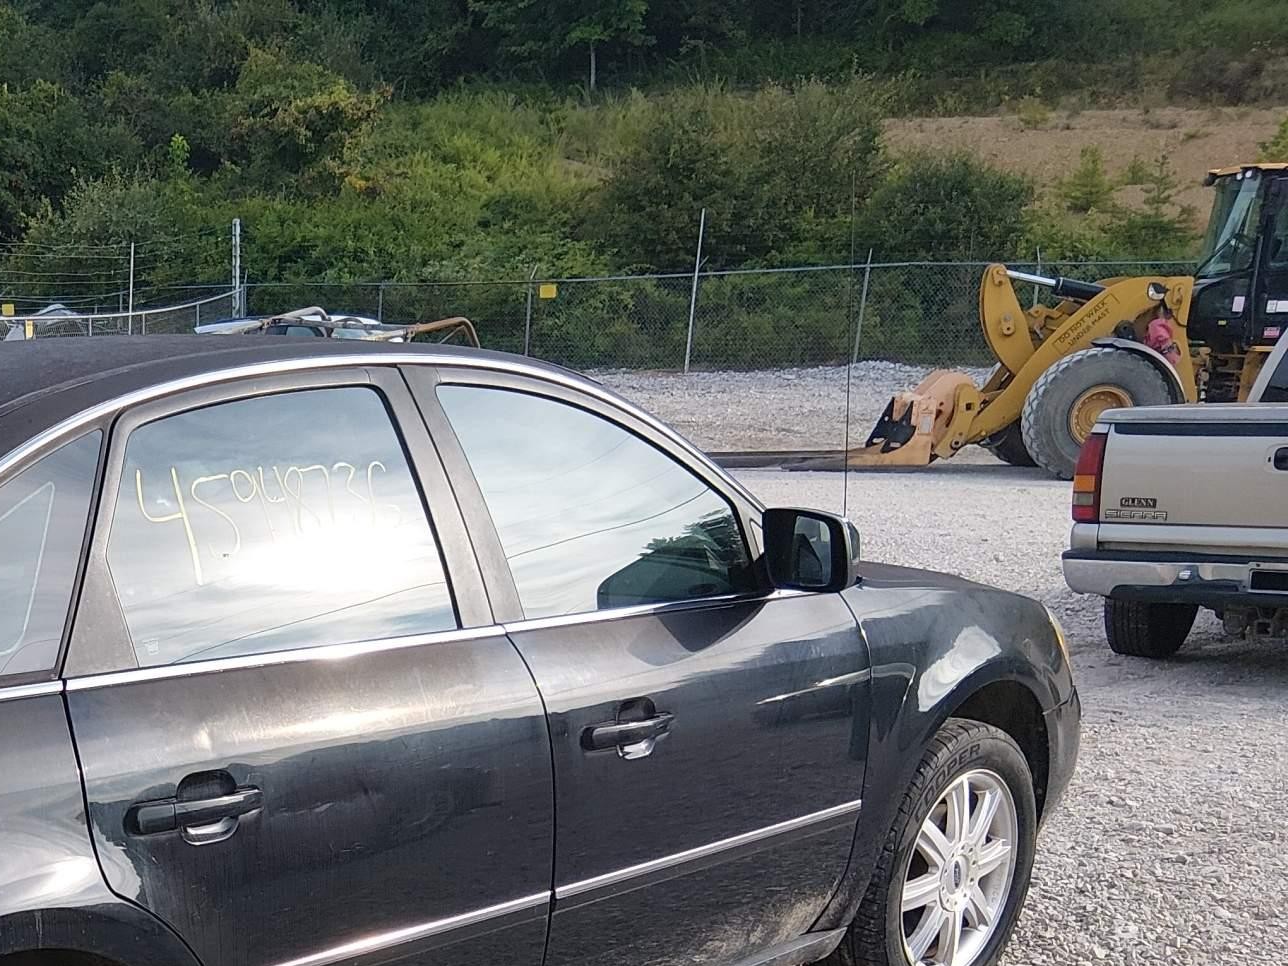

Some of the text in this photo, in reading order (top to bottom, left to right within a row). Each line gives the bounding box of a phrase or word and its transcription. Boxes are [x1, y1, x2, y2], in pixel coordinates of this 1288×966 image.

[1087, 301, 1108, 319] WALK
[1105, 509, 1168, 521] SIERRA
[914, 743, 981, 824] COOPER
